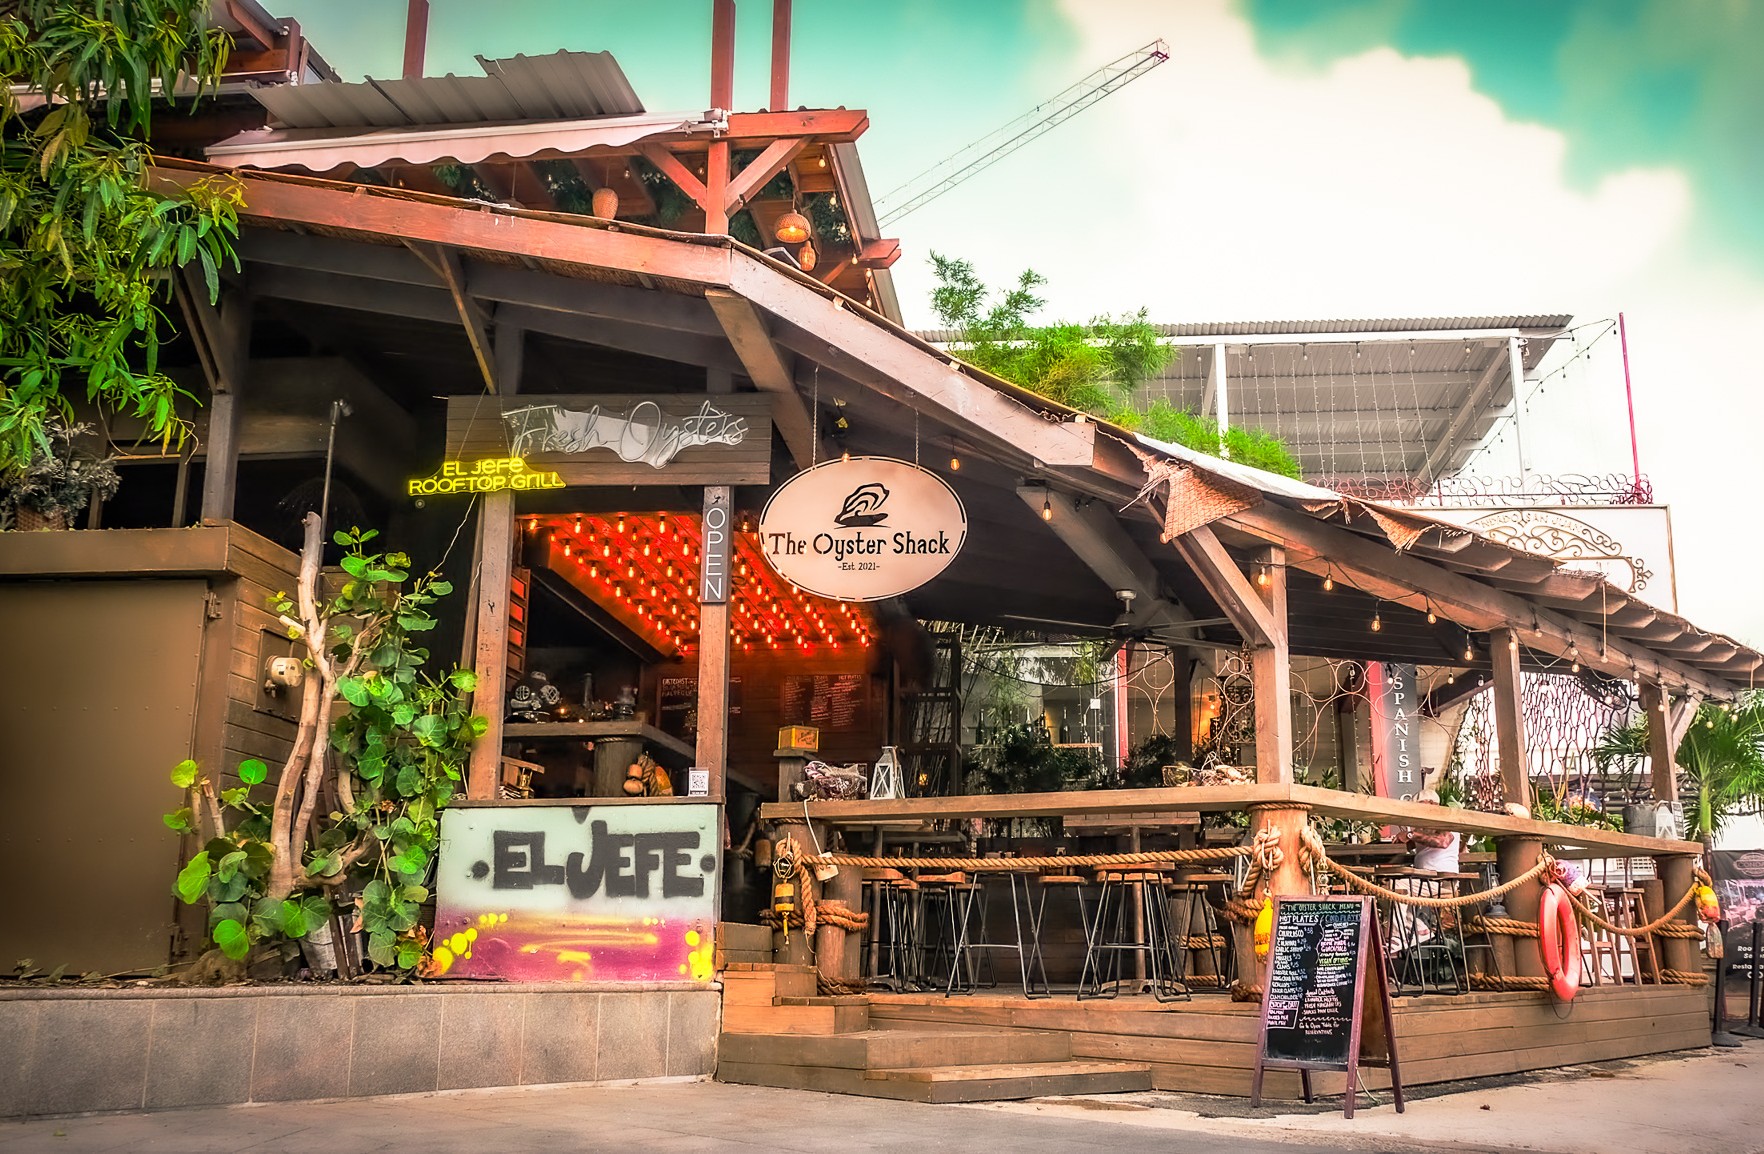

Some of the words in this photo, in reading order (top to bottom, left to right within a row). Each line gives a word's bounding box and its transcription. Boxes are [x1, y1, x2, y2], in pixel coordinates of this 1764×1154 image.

[502, 405, 618, 459] Fresh
[620, 400, 748, 469] Oysters
[443, 461, 468, 476] EL
[409, 475, 506, 494] ROOFTOP
[706, 507, 726, 600] OPEN
[769, 533, 807, 555] The
[813, 531, 887, 561] Oyster
[893, 531, 951, 555] Shack
[1393, 676, 1412, 783] SPANISH
[494, 830, 565, 889] EL
[566, 820, 704, 900] JEFE
[1279, 915, 1292, 923] HOT
[1292, 914, 1319, 923] PLATES
[1285, 904, 1297, 912] THE
